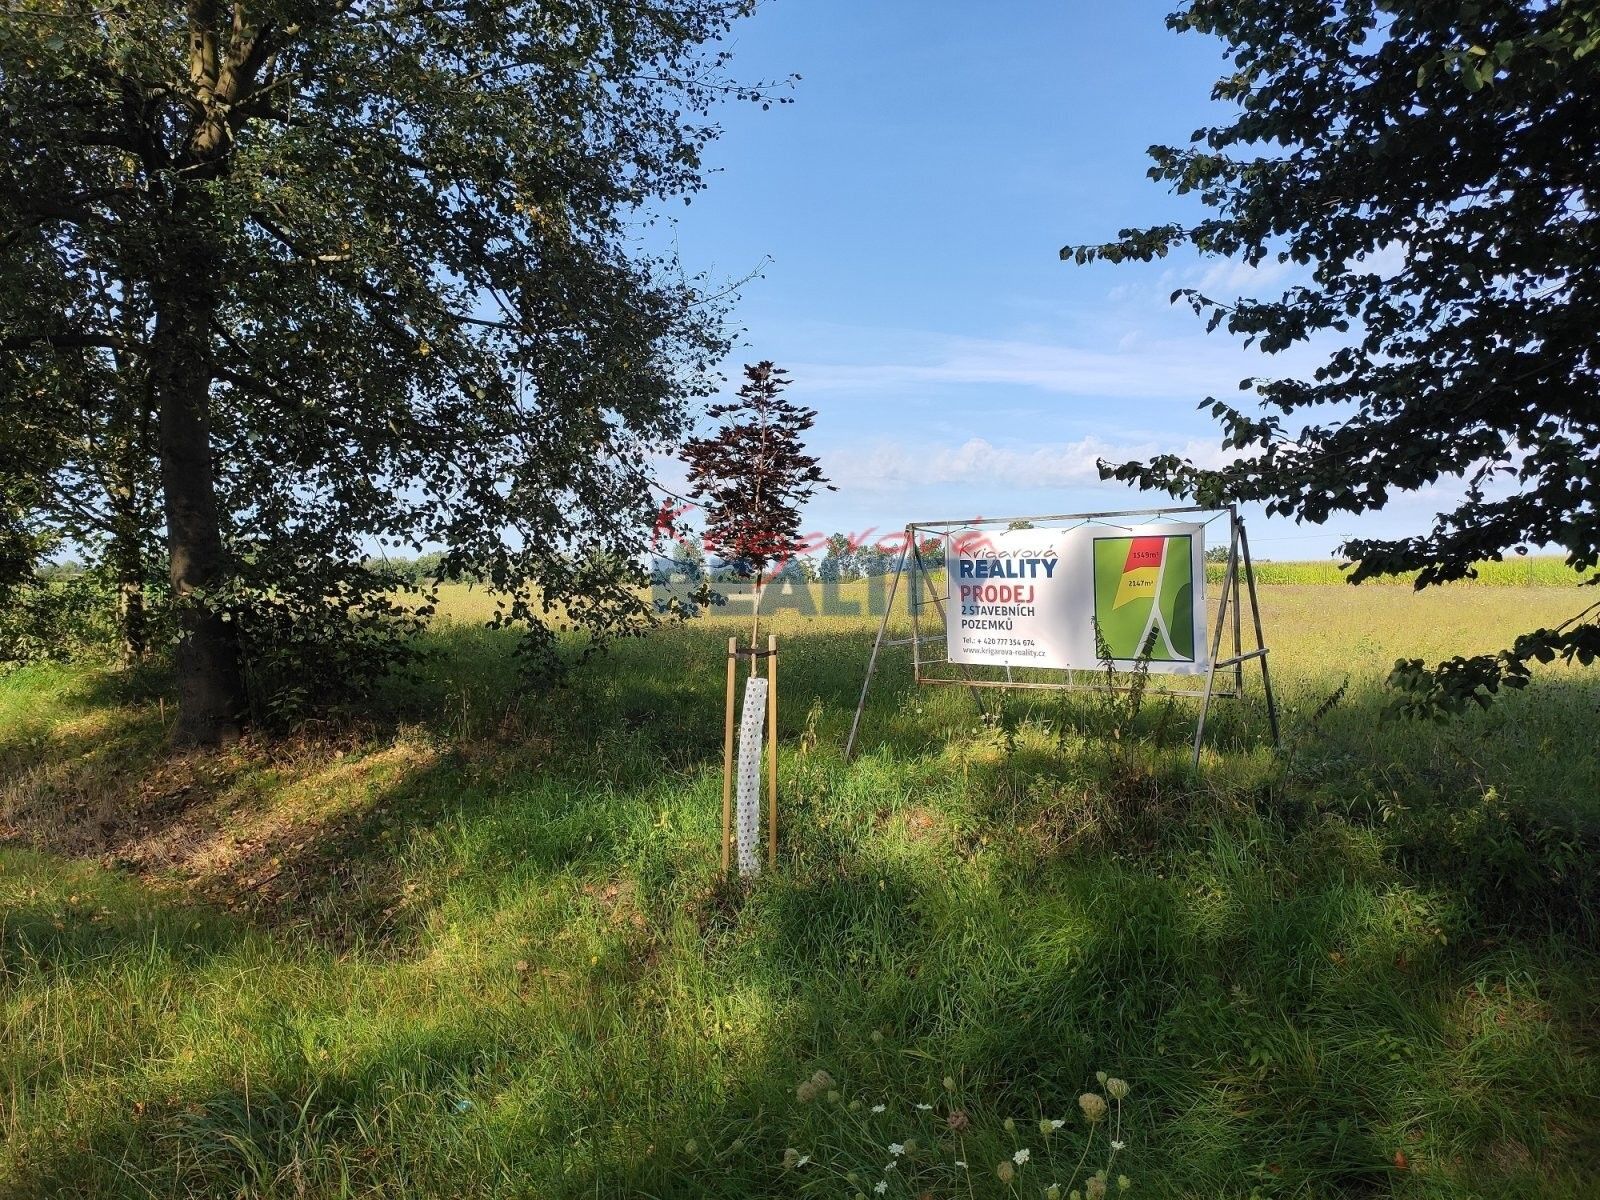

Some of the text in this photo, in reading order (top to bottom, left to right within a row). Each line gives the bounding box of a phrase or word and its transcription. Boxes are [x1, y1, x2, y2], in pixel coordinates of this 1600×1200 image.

[960, 541, 1059, 569] Krigarová
[960, 558, 1059, 579] REALITY
[960, 584, 1035, 604] PRODEJ
[961, 604, 1035, 617] 2 STAVEBNÍCH
[961, 617, 1013, 631] POZEMKŮ
[983, 637, 996, 646] 420
[997, 638, 1008, 646] 777
[1009, 638, 1021, 646] 354
[1022, 639, 1035, 647] 674
[962, 646, 1046, 659] www.krigarova-reality.cz
